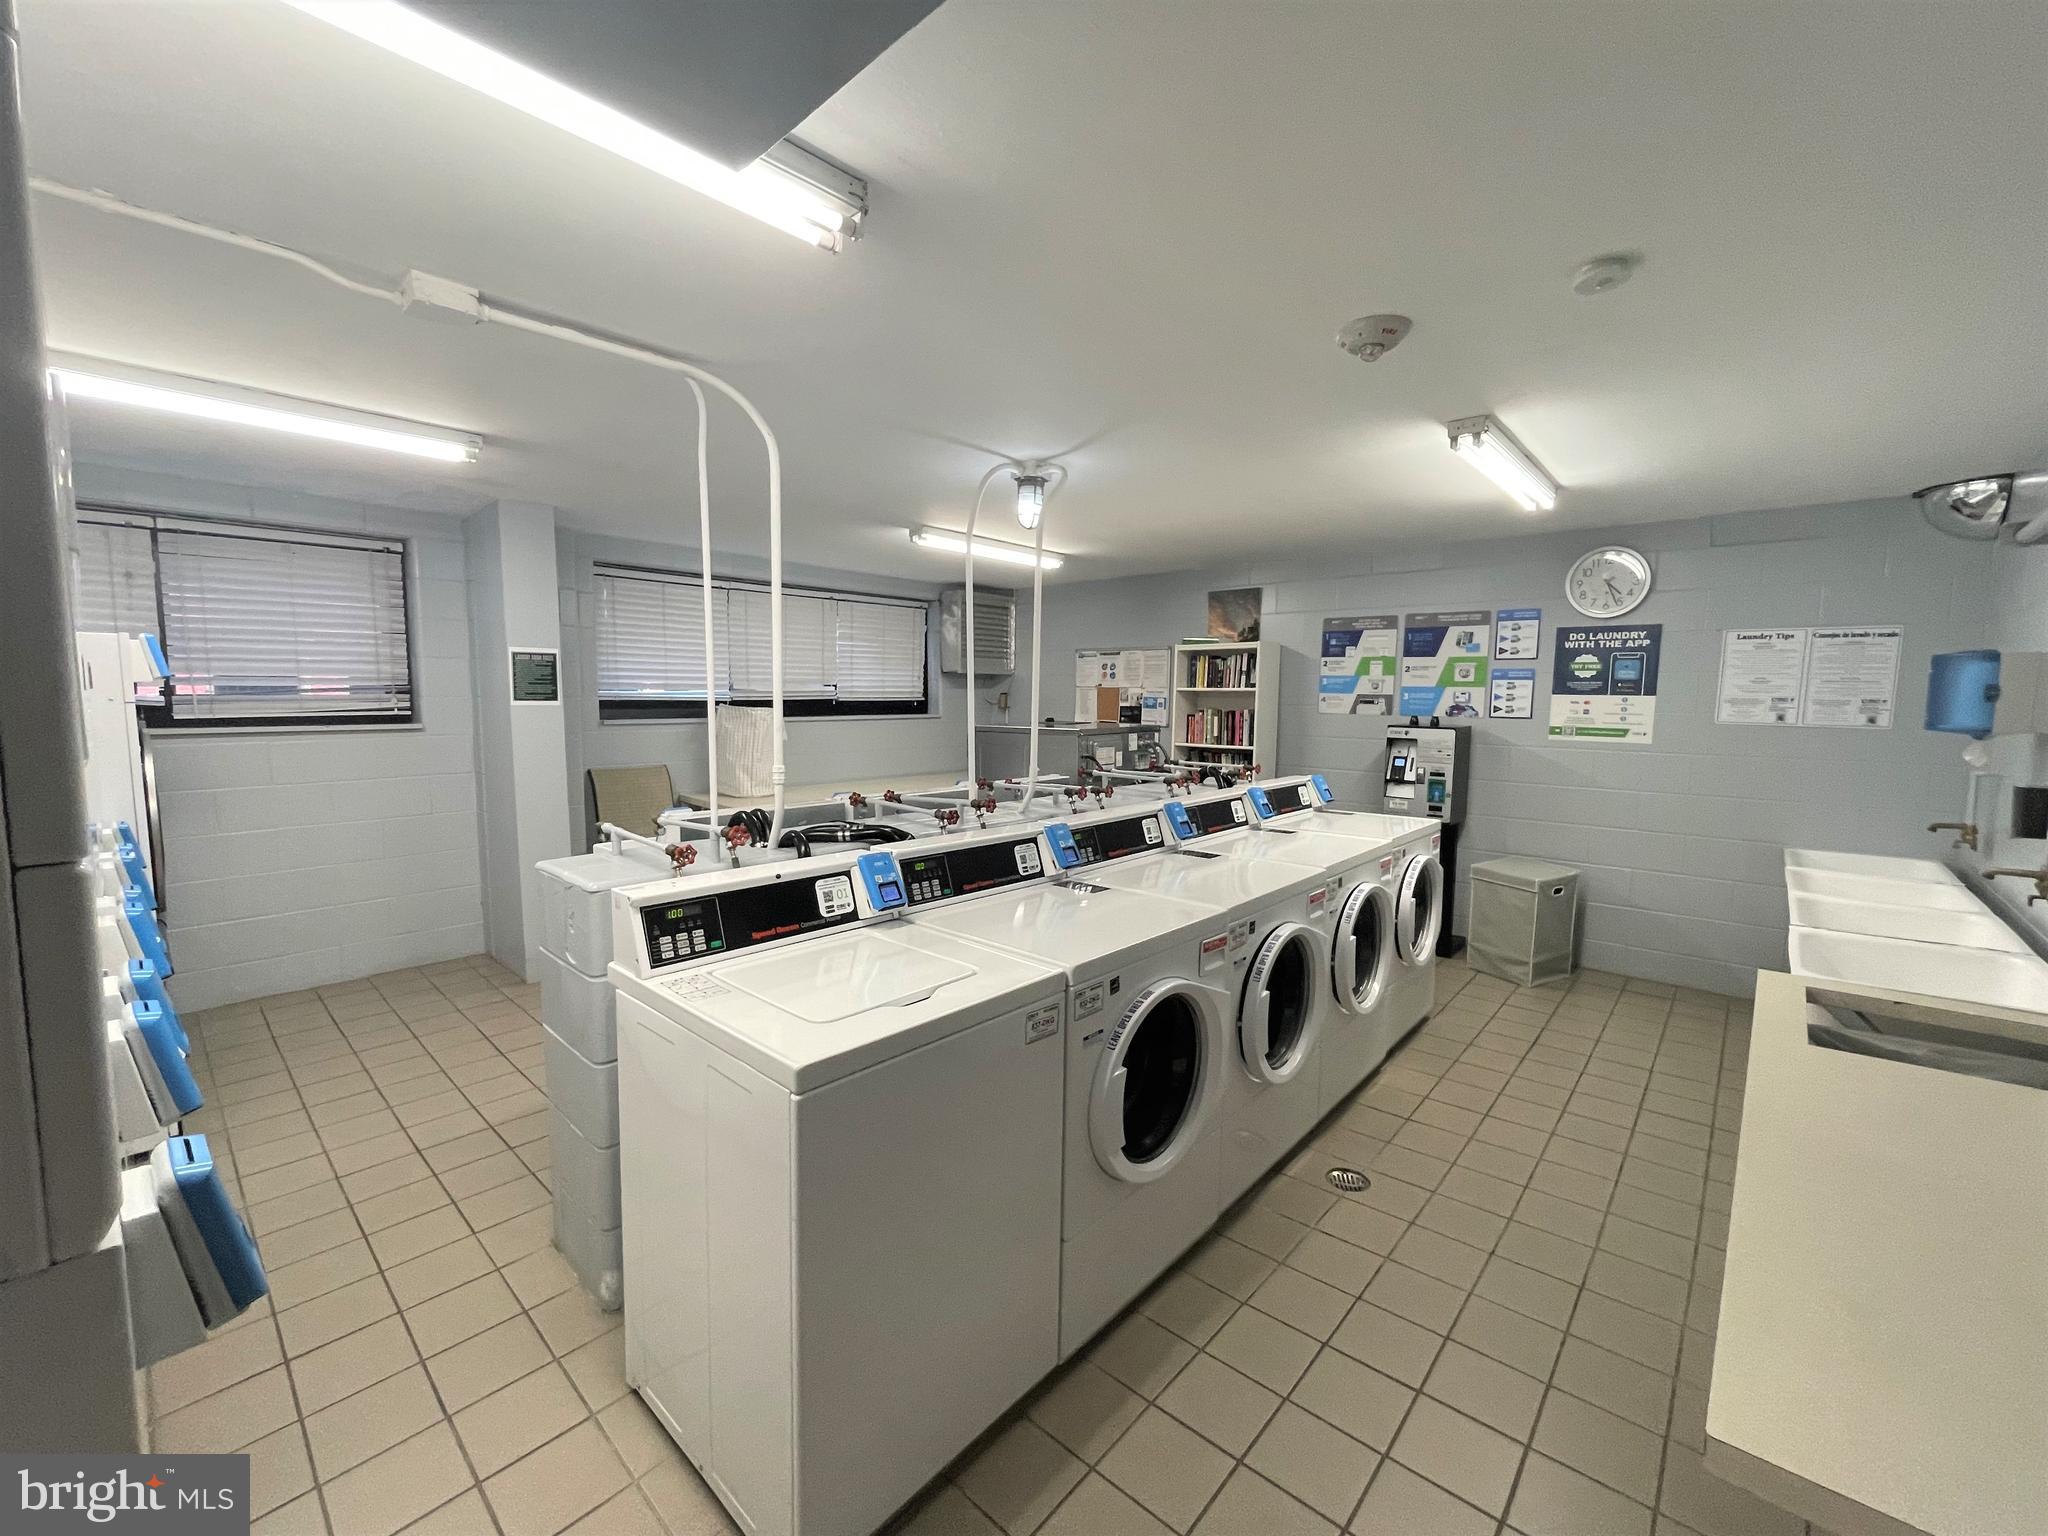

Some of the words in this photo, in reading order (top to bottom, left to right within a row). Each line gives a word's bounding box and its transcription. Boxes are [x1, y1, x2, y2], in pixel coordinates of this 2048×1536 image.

[1592, 559, 1600, 568] 11
[1583, 568, 1593, 577] 10
[1576, 580, 1583, 589] 9
[1579, 591, 1586, 600] 8
[1627, 588, 1633, 596] 4
[1590, 598, 1597, 607] 7
[1569, 632, 1585, 641] DO
[1589, 631, 1647, 640] LAUNDRY
[1736, 633, 1773, 641] Laundry
[1565, 641, 1595, 649] WITH
[1598, 640, 1622, 648] THE
[1626, 639, 1651, 647] APP
[837, 888, 849, 899] 01
[752, 927, 776, 940] Speed
[1106, 1030, 1122, 1051] LEAVE
[1117, 1014, 1133, 1029] OPEN
[1128, 999, 1144, 1014] WHEN
